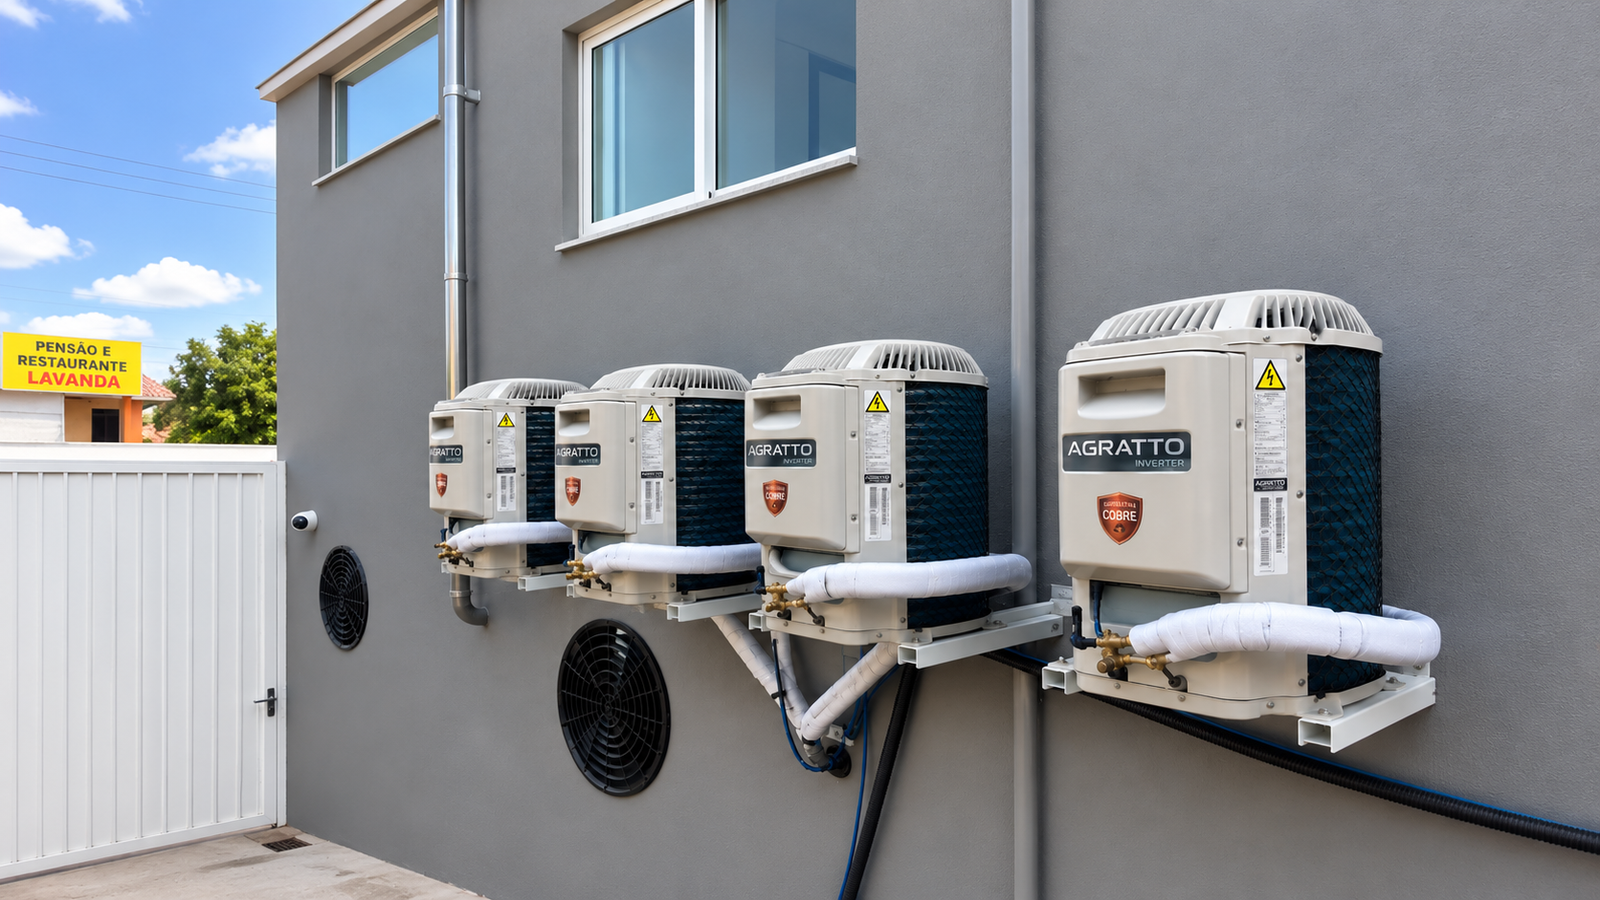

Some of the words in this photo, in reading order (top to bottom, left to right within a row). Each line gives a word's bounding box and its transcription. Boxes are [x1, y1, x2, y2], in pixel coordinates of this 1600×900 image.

[35, 341, 97, 355] PENSÃO
[103, 346, 111, 356] E
[18, 355, 127, 372] RESTAURANTE
[28, 371, 120, 388] LAVANDA
[556, 447, 598, 457] AGRATTO
[748, 444, 812, 456] AGRATTO
[1068, 438, 1184, 456] AGRATTO
[1135, 459, 1185, 468] INVERTER
[1102, 509, 1137, 522] COBRE
